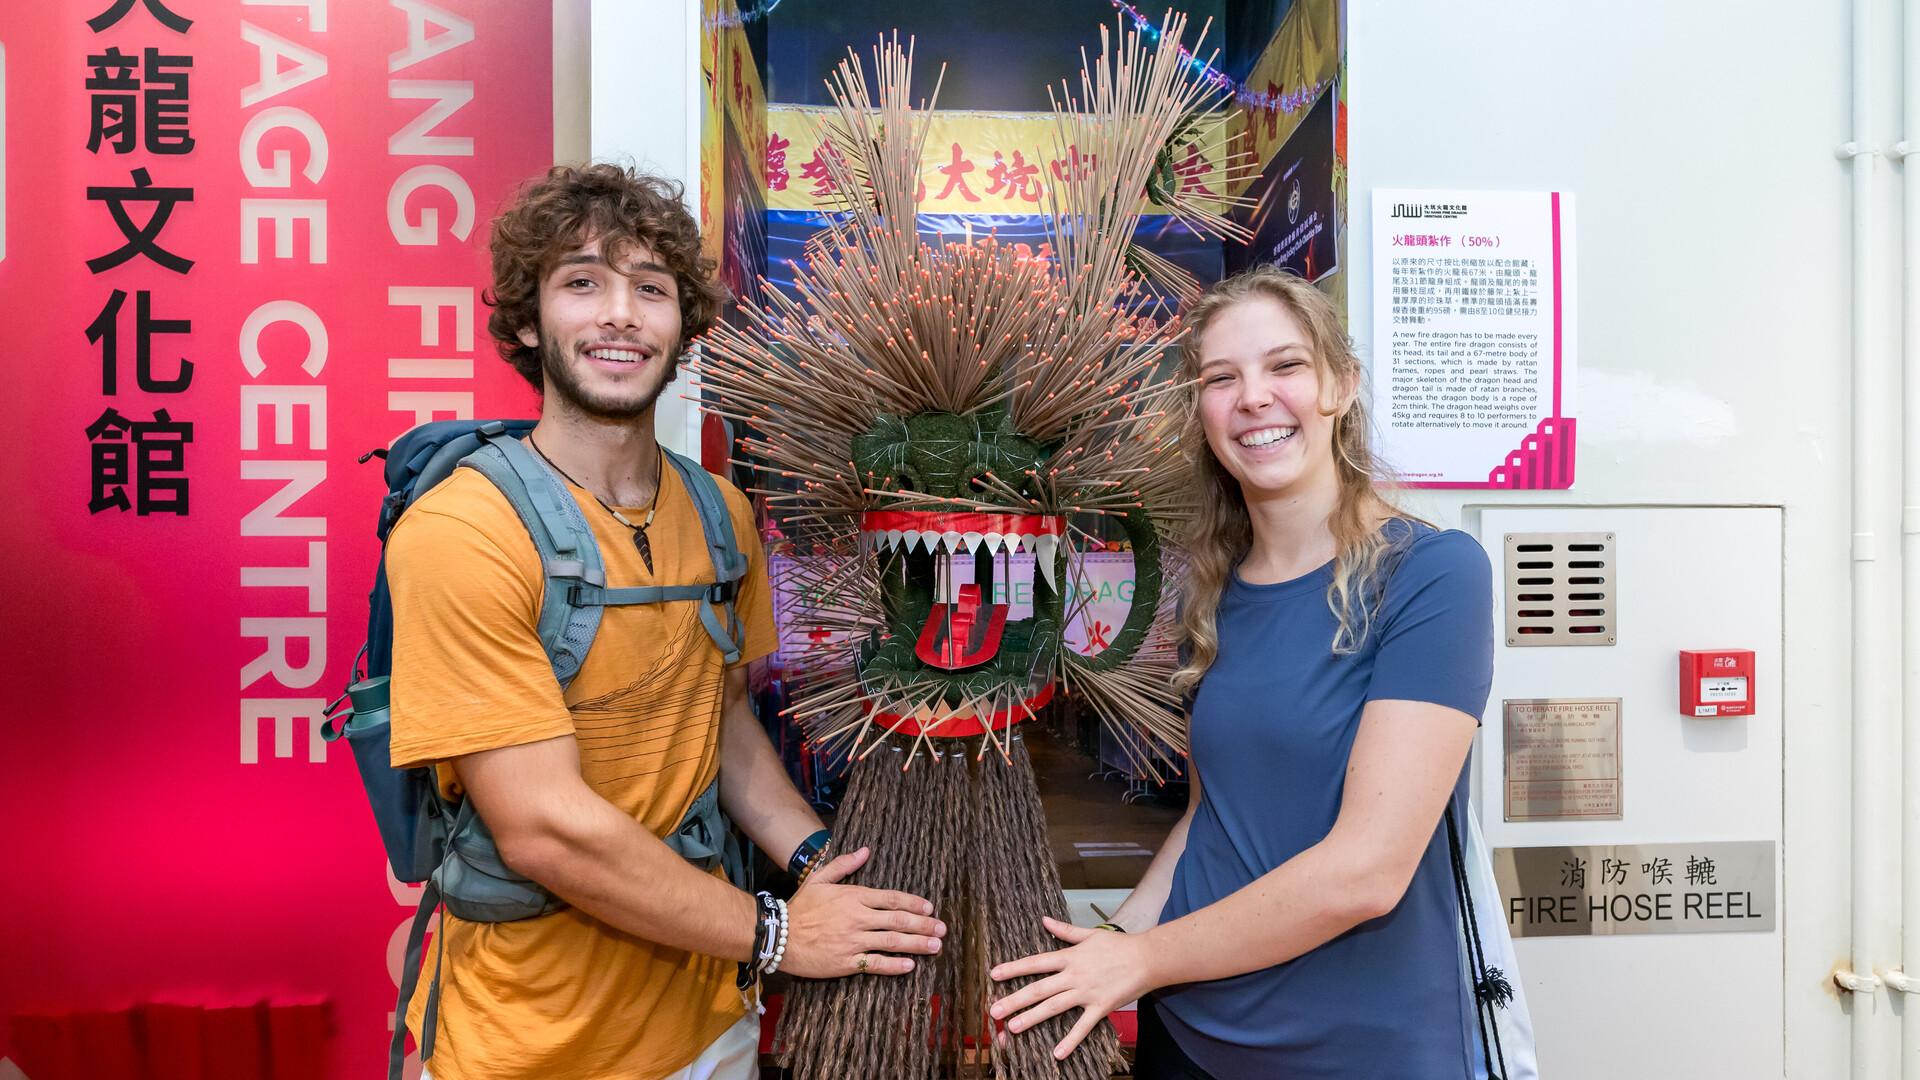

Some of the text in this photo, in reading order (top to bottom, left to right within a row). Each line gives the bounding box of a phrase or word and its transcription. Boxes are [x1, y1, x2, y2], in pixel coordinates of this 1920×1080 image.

[1392, 234, 1452, 246] 火龍頭紮作
[1432, 332, 1458, 340] dragon
[1469, 341, 1495, 349] dragon
[1509, 350, 1528, 358] body
[1502, 359, 1512, 367] by
[1470, 367, 1488, 375] pearl
[1474, 376, 1501, 384] dragon
[1392, 385, 1419, 393] dragon
[1441, 394, 1468, 402] dragon
[1471, 394, 1490, 402] body
[1446, 403, 1473, 411] dragon
[1494, 403, 1519, 411] weighs
[1392, 412, 1411, 420] 45kg
[1429, 412, 1458, 420] requires
[1487, 412, 1527, 421] performers
[1416, 421, 1461, 429] alternatively
[240, 301, 328, 764] CENTRE
[1560, 855, 1717, 889] 消防喉轆
[1510, 892, 1762, 924] FIRE HOSE REEL
